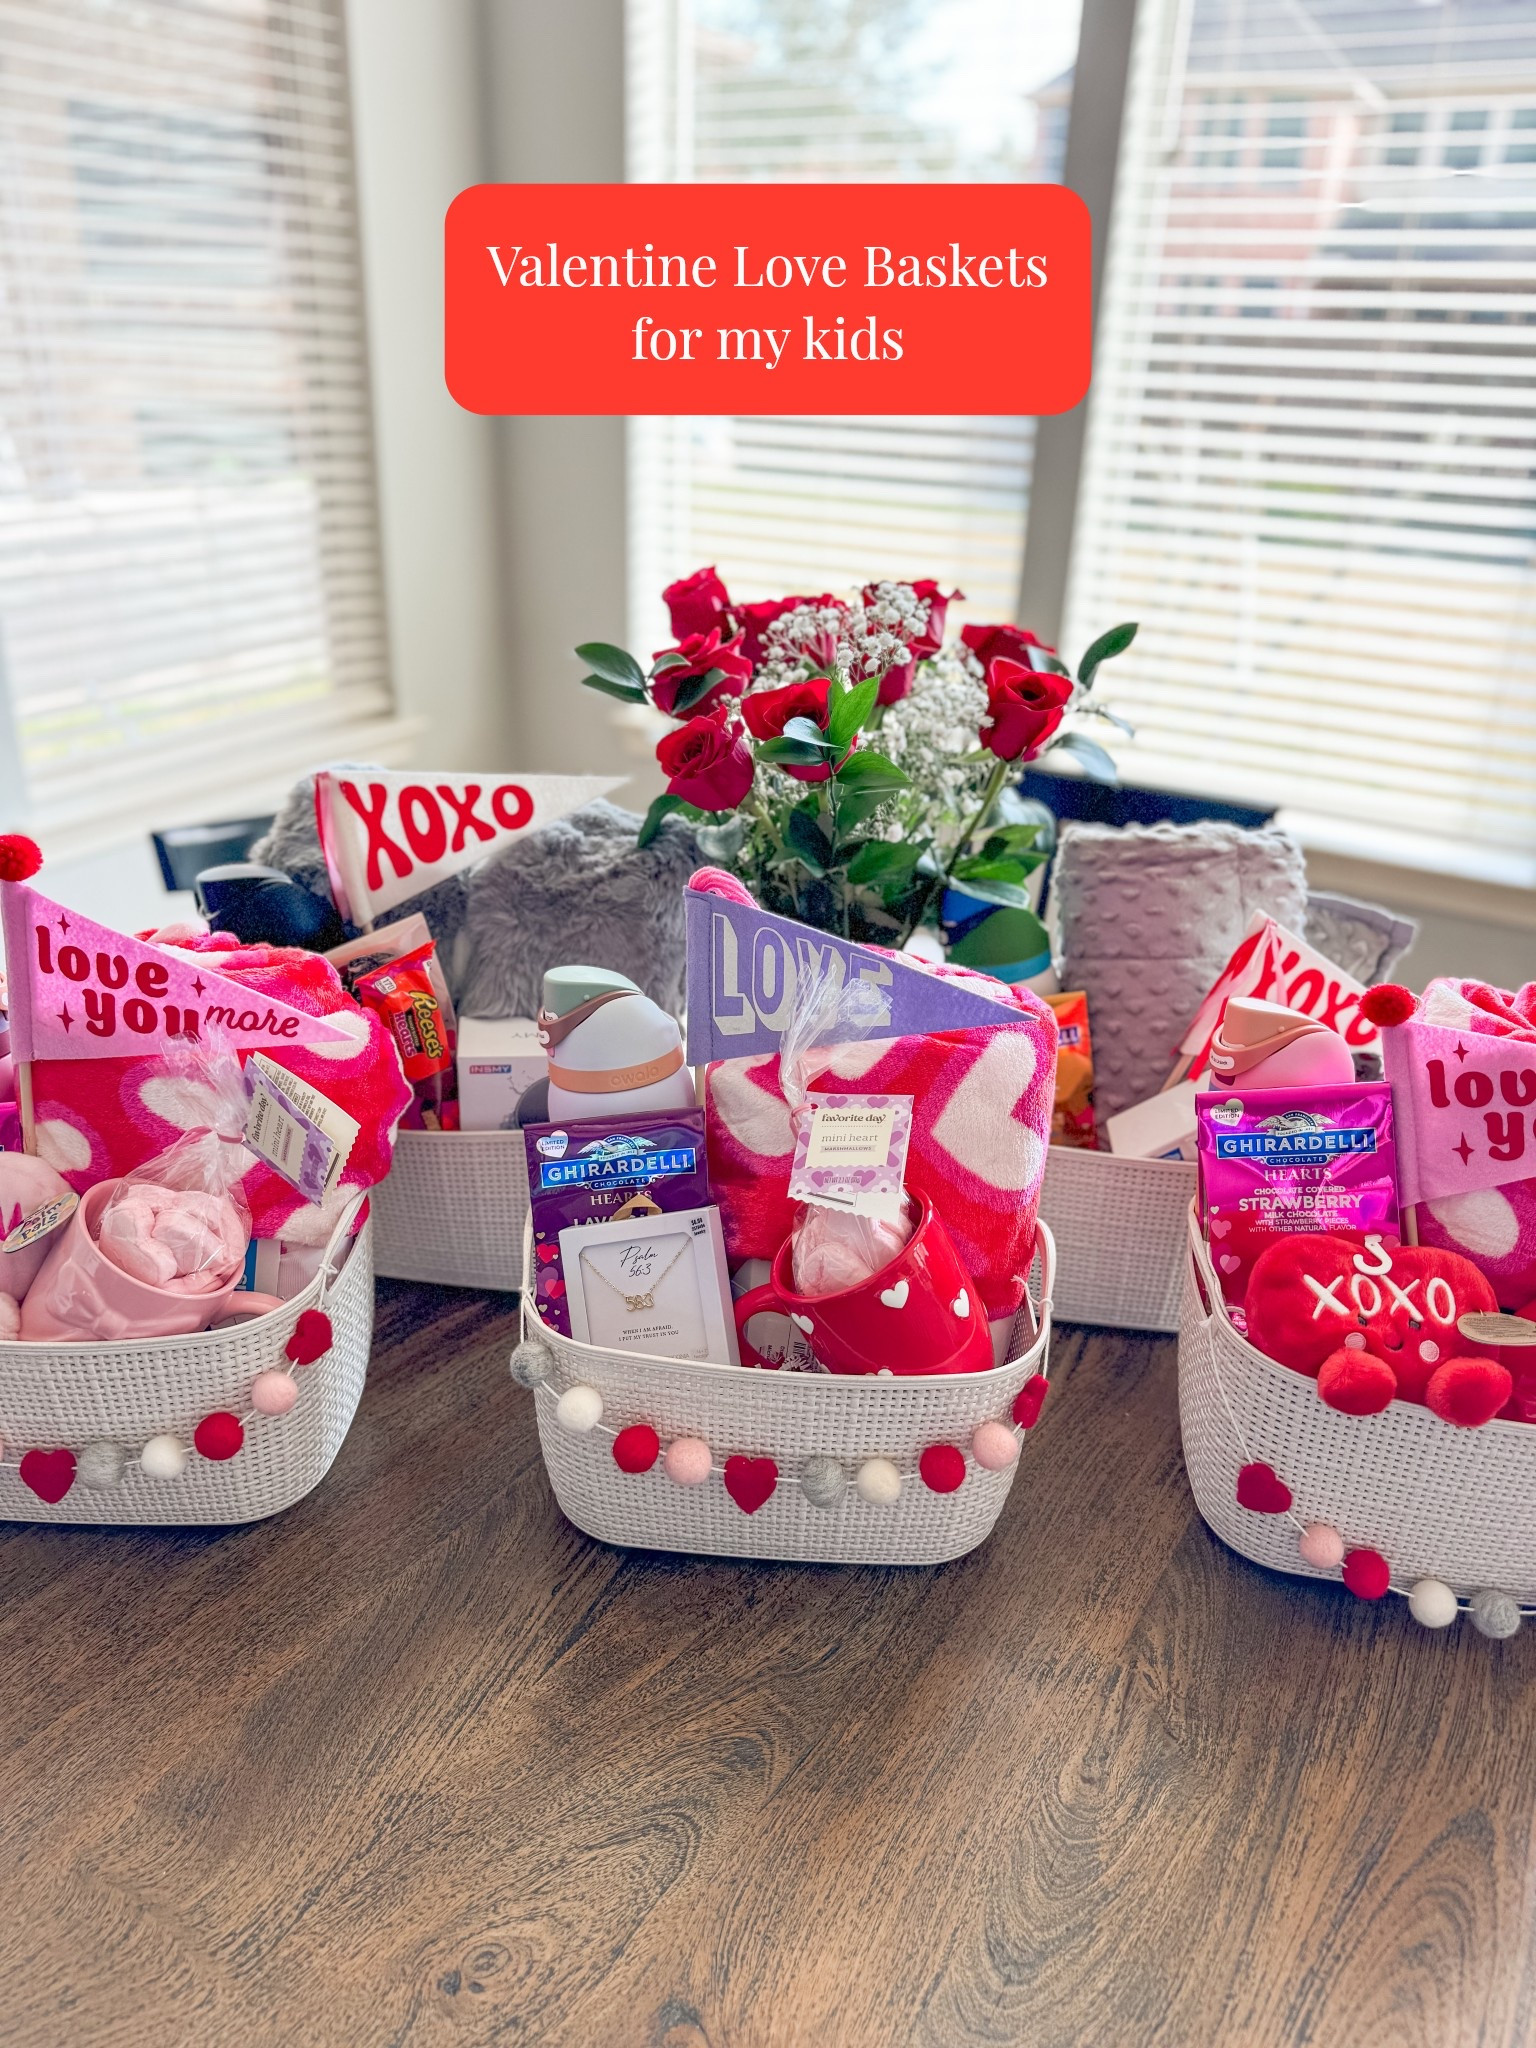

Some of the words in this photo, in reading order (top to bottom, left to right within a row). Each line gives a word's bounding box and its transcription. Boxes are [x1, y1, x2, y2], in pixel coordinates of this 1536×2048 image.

[339, 781, 534, 891] XOXO
[36, 925, 169, 998] love
[713, 913, 893, 1035] LOVE
[82, 989, 202, 1043] you
[204, 1005, 299, 1038] more
[409, 990, 443, 1060] Reese's
[394, 1011, 418, 1058] Hearts
[470, 1065, 510, 1074] INSMY
[610, 1065, 660, 1087] owala
[276, 1115, 285, 1137] heart
[822, 1113, 864, 1122] favorite
[865, 1113, 887, 1124] day
[822, 1133, 846, 1142] mini
[849, 1133, 878, 1142] heart
[1223, 1134, 1370, 1154] GHIRARDELLI
[548, 1154, 690, 1181] GHIRARDELLI
[1269, 1156, 1323, 1164] CHOCOLATE
[594, 1178, 646, 1188] CHOCOLATE
[1264, 1168, 1332, 1181] HEARTS
[1254, 1187, 1303, 1195] CHOCOLATE
[1306, 1185, 1346, 1193] COVERED
[1239, 1194, 1364, 1211] STRAWBERRY
[1264, 1211, 1284, 1219] MILK
[1287, 1210, 1338, 1218] CHOCOLATE
[620, 1245, 658, 1268] Psalm
[628, 1264, 652, 1277] 56:3
[1303, 1273, 1456, 1325] XOXO
